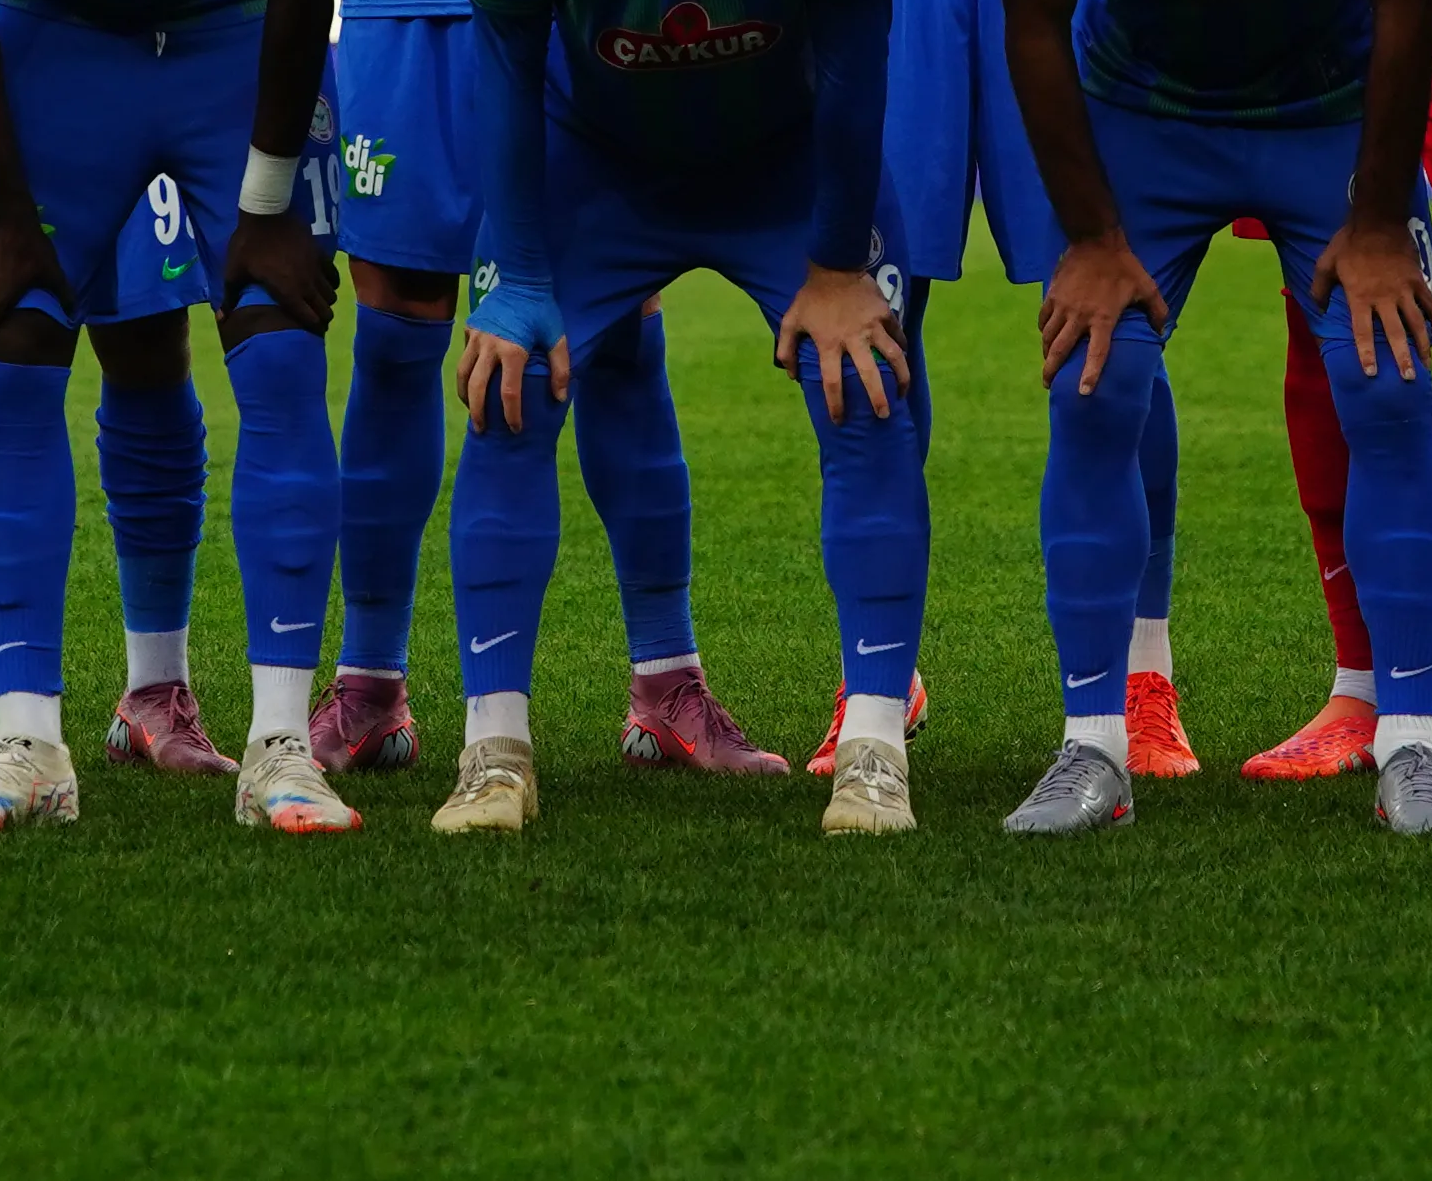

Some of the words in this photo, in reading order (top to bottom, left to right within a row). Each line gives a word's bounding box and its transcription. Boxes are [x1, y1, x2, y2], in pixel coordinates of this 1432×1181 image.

[615, 31, 764, 64] ÇAYKUR
[345, 134, 371, 171] di
[355, 160, 385, 196] di
[147, 172, 195, 245] 9
